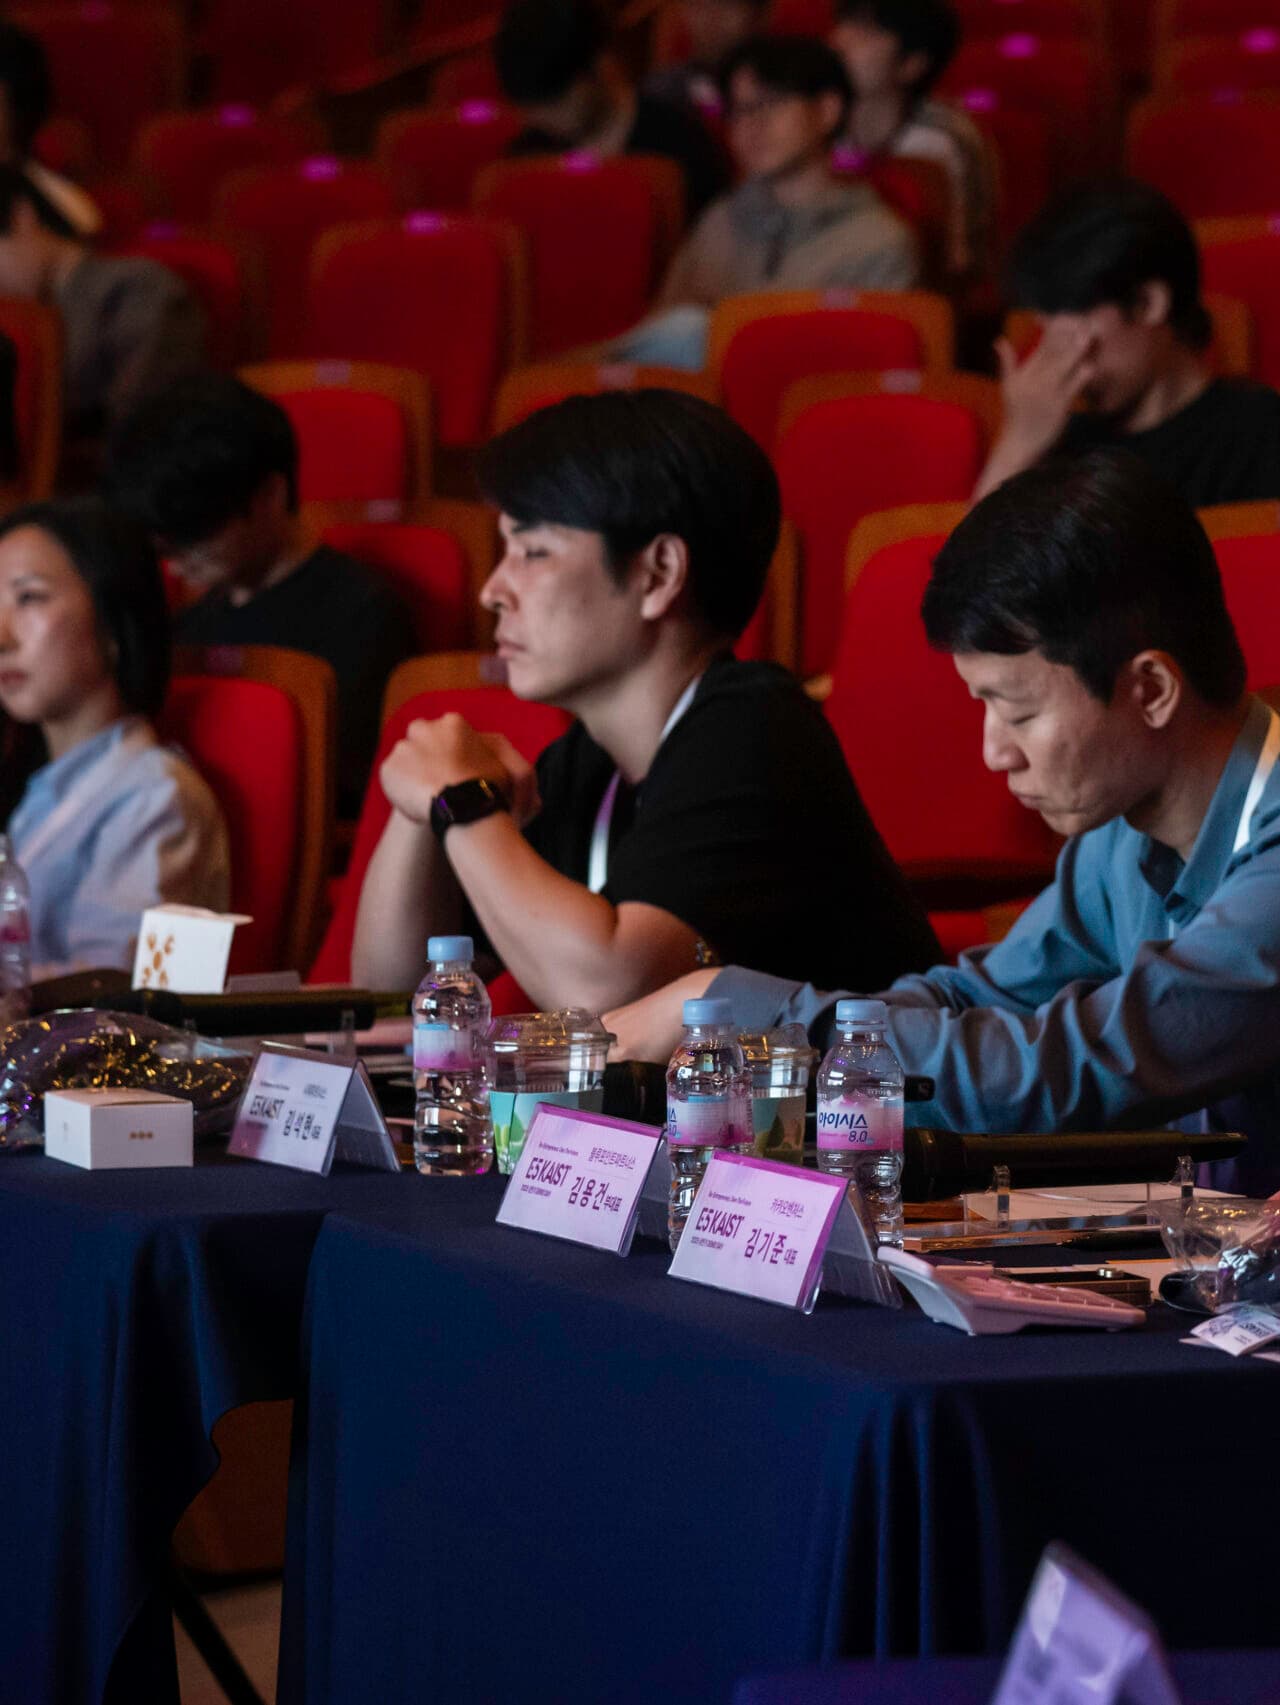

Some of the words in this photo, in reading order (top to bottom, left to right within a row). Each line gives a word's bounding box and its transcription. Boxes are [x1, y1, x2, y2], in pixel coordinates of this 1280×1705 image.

[818, 1112, 868, 1129] 아이시스
[848, 1130, 868, 1142] 8.0
[568, 1176, 610, 1211] 김용건
[744, 1227, 788, 1264] 김기준
